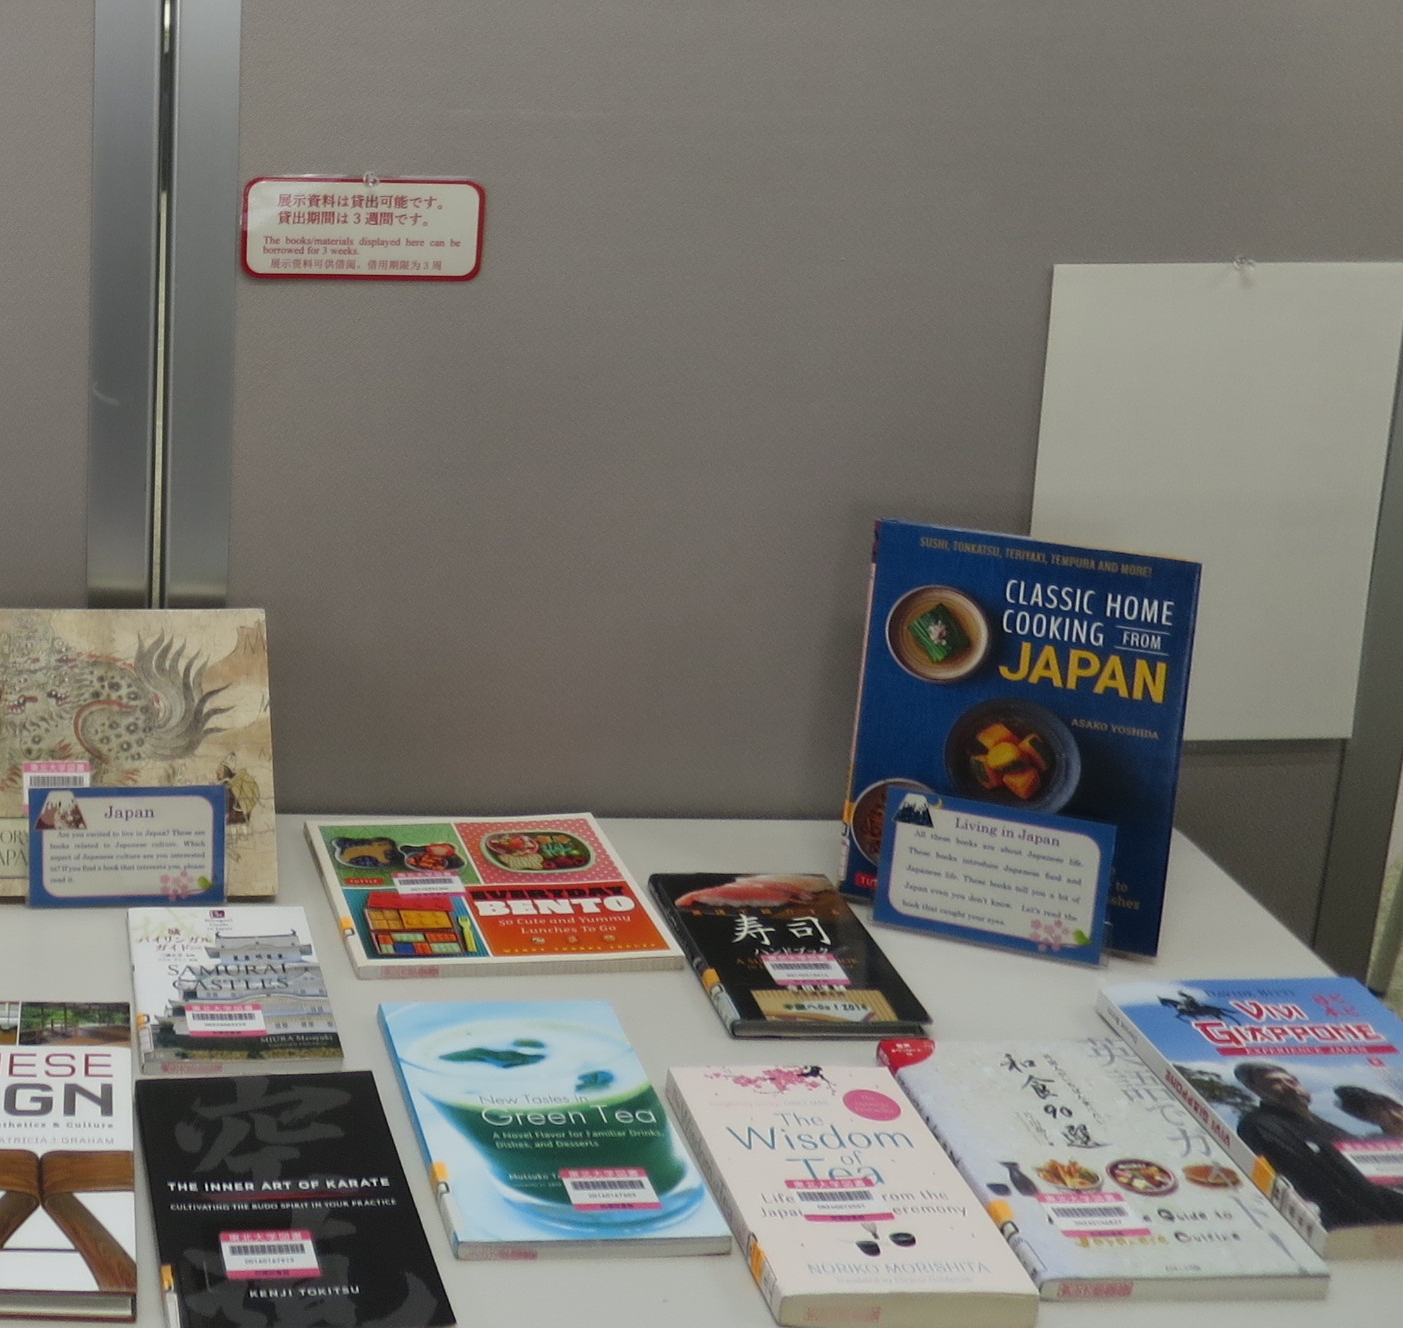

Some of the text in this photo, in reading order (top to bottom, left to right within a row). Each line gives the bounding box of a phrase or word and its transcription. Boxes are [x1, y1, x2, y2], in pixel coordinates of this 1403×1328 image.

[278, 194, 443, 210] 展示資料は貸出可能です。
[263, 236, 461, 248] The books/materials displayed here can be
[263, 246, 359, 256] borrowed for 3 weeks.
[920, 537, 1153, 577] SUSHI, TONKATSU, TERIYAKI, TEMPURA AND MORE!
[1005, 579, 1175, 627] CLASSIC HOME
[1002, 609, 1105, 647] COOKING
[1122, 630, 1162, 650] FROM
[998, 642, 1168, 704] JAPAN
[1071, 718, 1159, 740] ASAKO YOSHIDA
[104, 805, 155, 821] Japan
[955, 817, 1060, 847] Living in Japan
[471, 886, 624, 901] EVERYDAY
[473, 895, 636, 917] BENTO
[498, 919, 513, 927] 50
[550, 916, 575, 924] and
[578, 915, 631, 924] Yummy
[521, 924, 617, 935] Lunches To Go
[732, 913, 832, 946] 寿司
[168, 963, 287, 977] SAMURAI
[172, 977, 289, 991] CASTLES
[1192, 1020, 1387, 1047] GIAPPONE
[478, 1095, 519, 1105] New
[525, 1094, 570, 1105] Tastes
[481, 1104, 658, 1126] Green Tea
[774, 1112, 823, 1127] The
[61, 1137, 115, 1145] GRAHAM
[502, 1131, 533, 1140] Novel
[535, 1131, 565, 1139] Flavor
[586, 1130, 626, 1138] Familiar
[629, 1129, 663, 1138] Drinks,
[726, 1124, 916, 1151] Wisdom
[841, 1150, 862, 1166] of
[785, 1157, 886, 1184] Tea
[167, 1177, 391, 1193] THE INNER ART OF KARATE
[170, 1198, 397, 1211] CULTIVATING THE BUDO SPIRIT IN YOUR PRACTICE
[760, 1189, 949, 1204] Life rom the
[893, 1204, 968, 1218] eremony
[807, 1262, 992, 1275] NORIKO MORISHITA
[249, 1285, 360, 1299] KENJI TOKITSU
